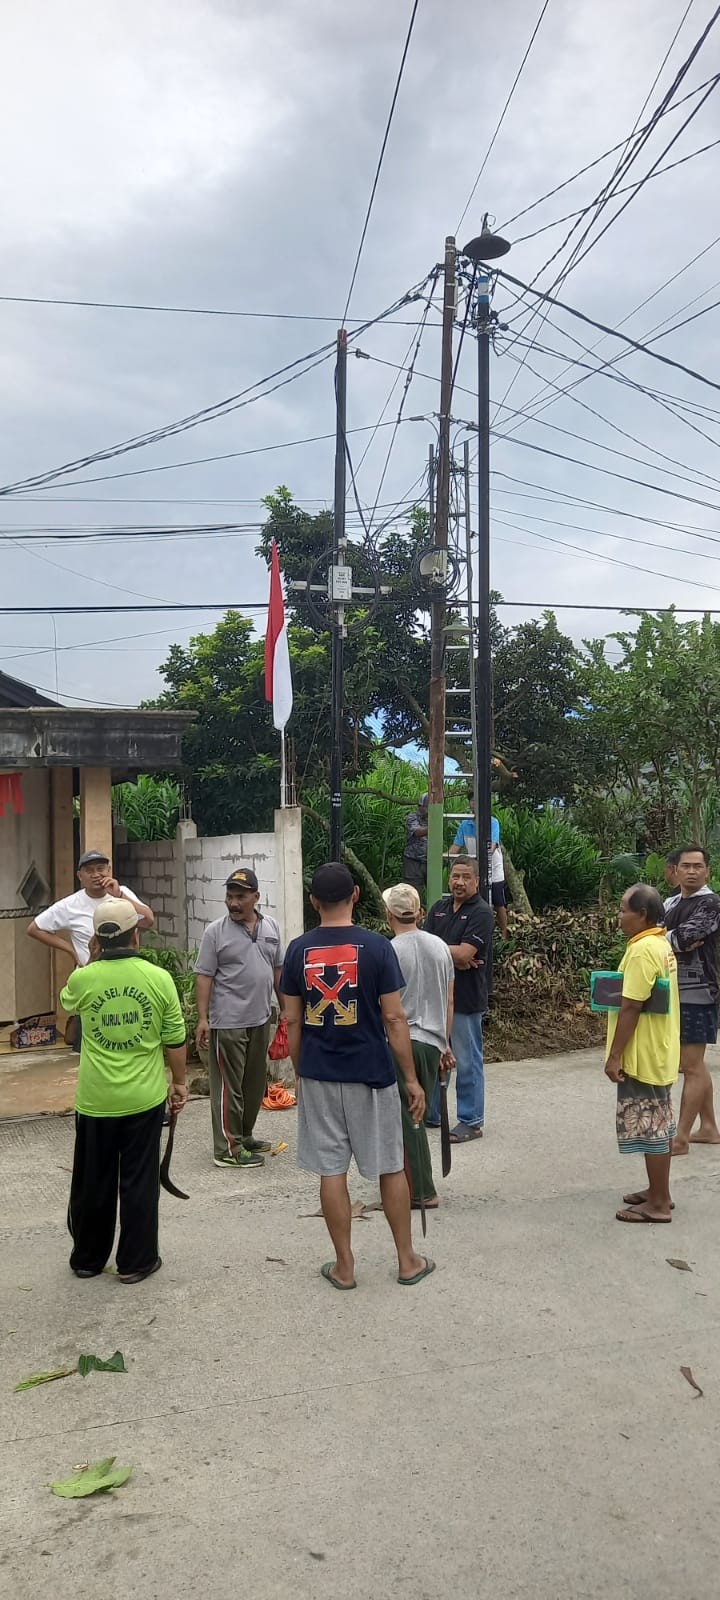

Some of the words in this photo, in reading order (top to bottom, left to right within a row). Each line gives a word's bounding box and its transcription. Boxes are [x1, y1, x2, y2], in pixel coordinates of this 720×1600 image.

[122, 986, 153, 1018] KELEDANG
[101, 1013, 121, 1027] NURUL
[121, 1010, 139, 1025] YAQIN
[91, 1026, 135, 1051] SAMARINDA
